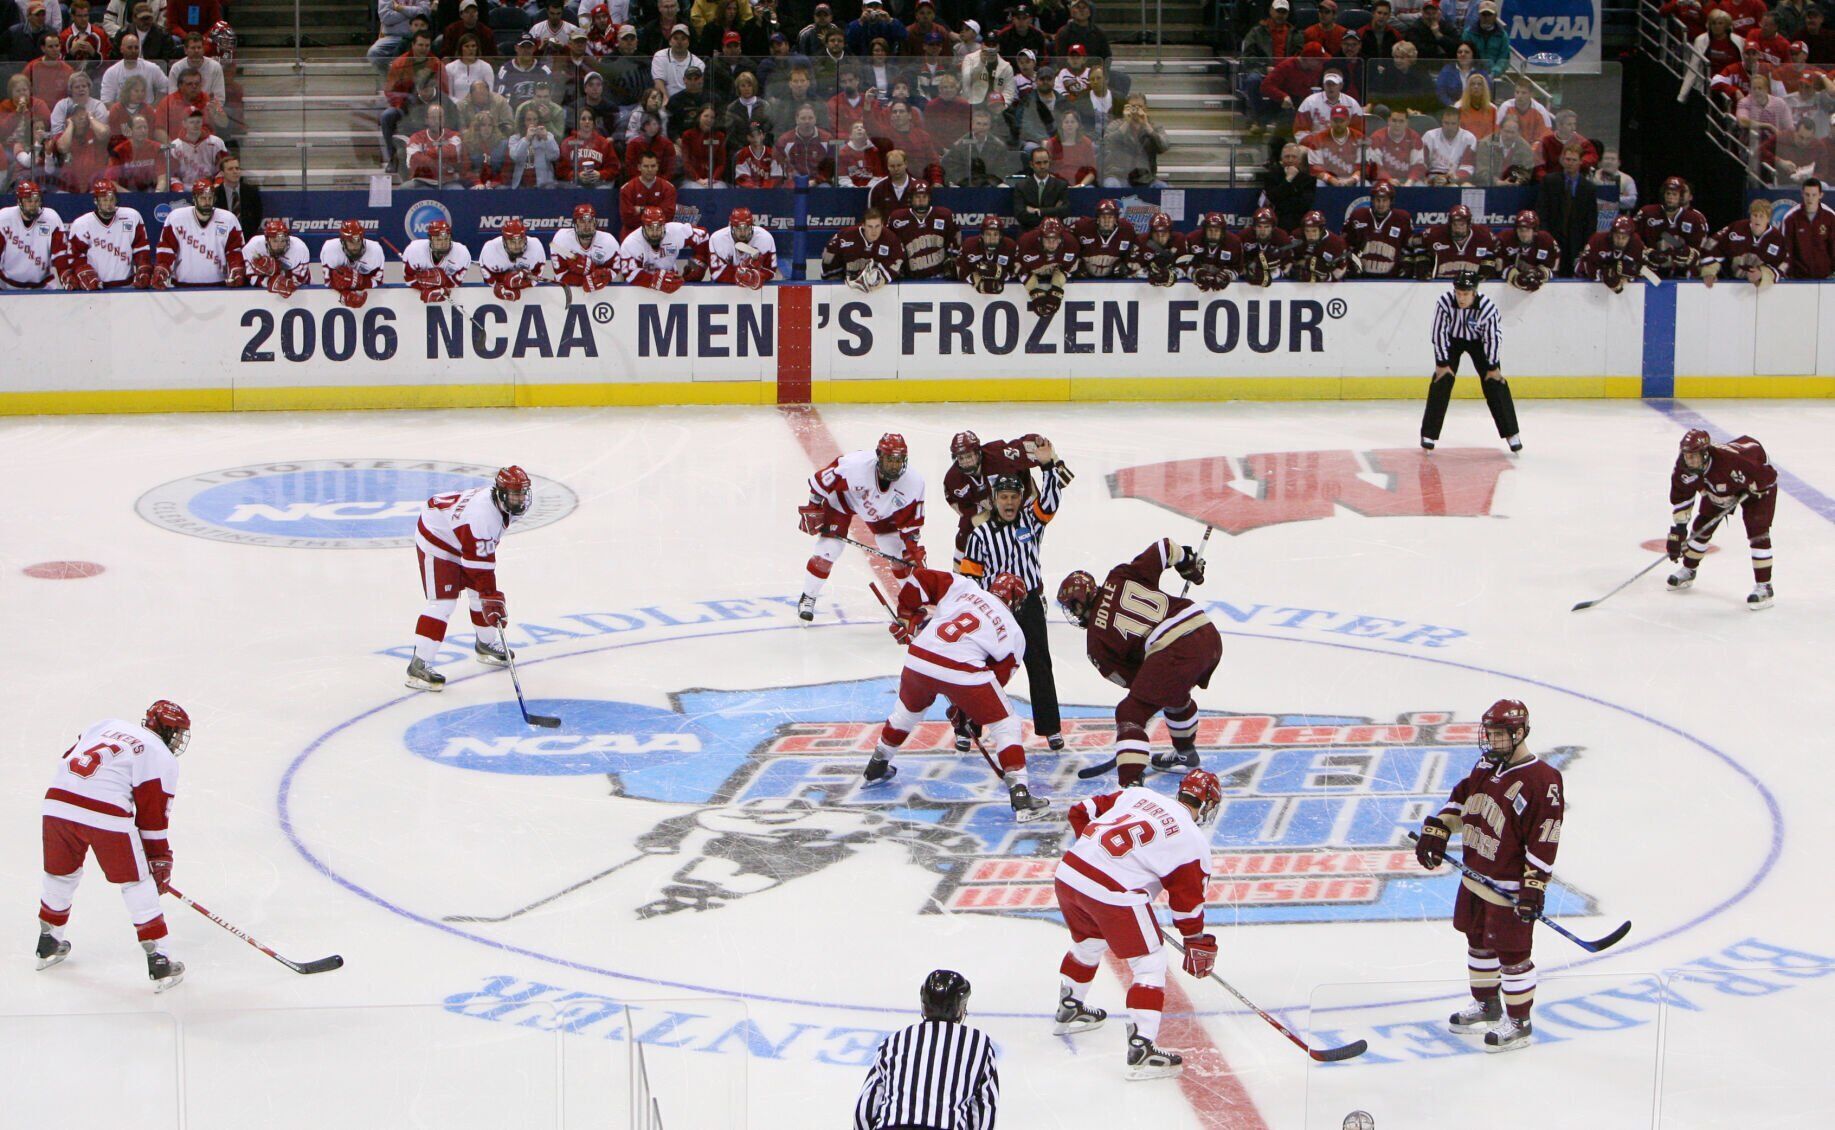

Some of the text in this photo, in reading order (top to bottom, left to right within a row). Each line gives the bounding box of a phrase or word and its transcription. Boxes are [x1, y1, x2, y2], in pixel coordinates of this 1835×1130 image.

[240, 307, 398, 363] 2006
[902, 301, 1140, 355] FROZEN
[935, 612, 981, 644] 8
[955, 592, 1008, 644] PAVELSKI
[1094, 581, 1118, 631] BOYLE
[1112, 579, 1170, 641] 10
[68, 742, 125, 780] 5
[440, 732, 701, 758] NCAA
[1081, 813, 1158, 859] 16
[1133, 798, 1181, 839] BURISH
